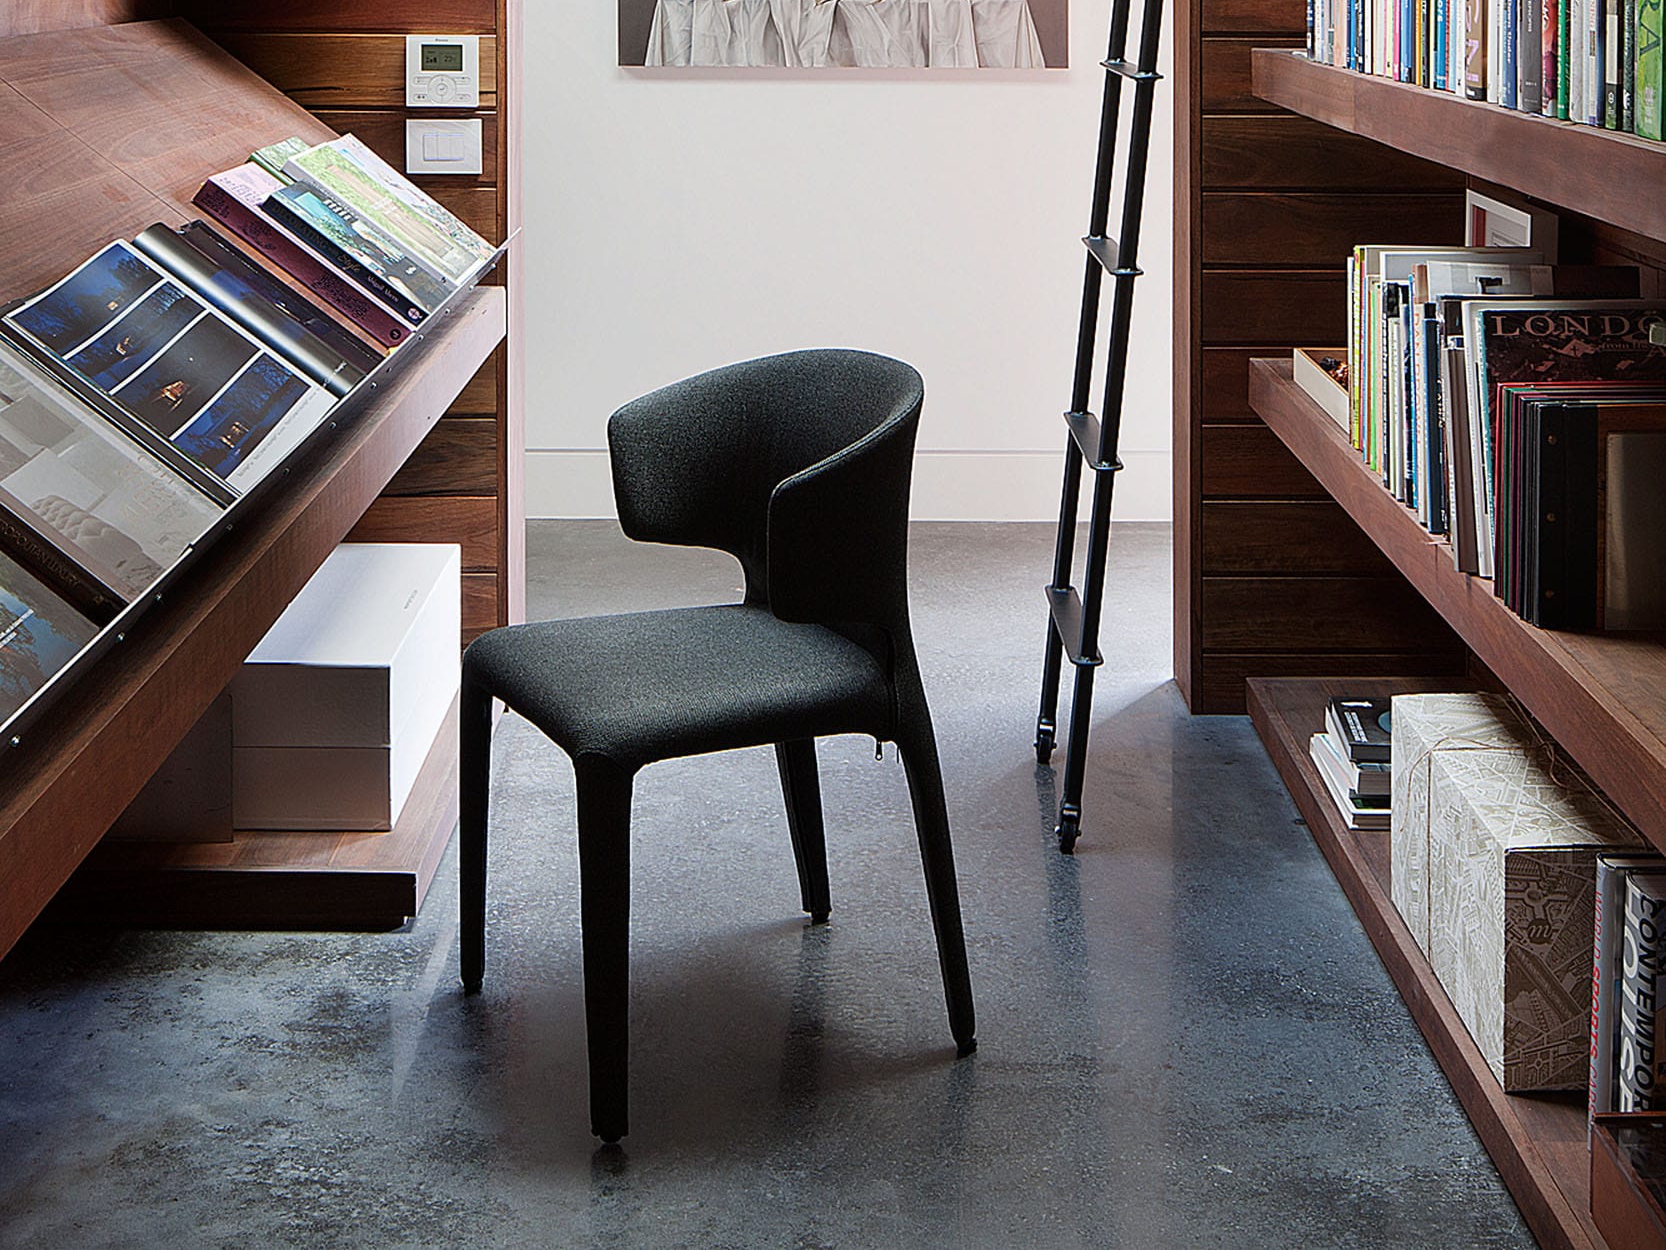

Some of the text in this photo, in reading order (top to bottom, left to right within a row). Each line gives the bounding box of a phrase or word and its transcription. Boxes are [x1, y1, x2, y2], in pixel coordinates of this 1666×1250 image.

[336, 253, 361, 273] Style
[1587, 890, 1603, 1117] WORLD SPORTS CARS
[1619, 884, 1641, 1113] HOUSE
